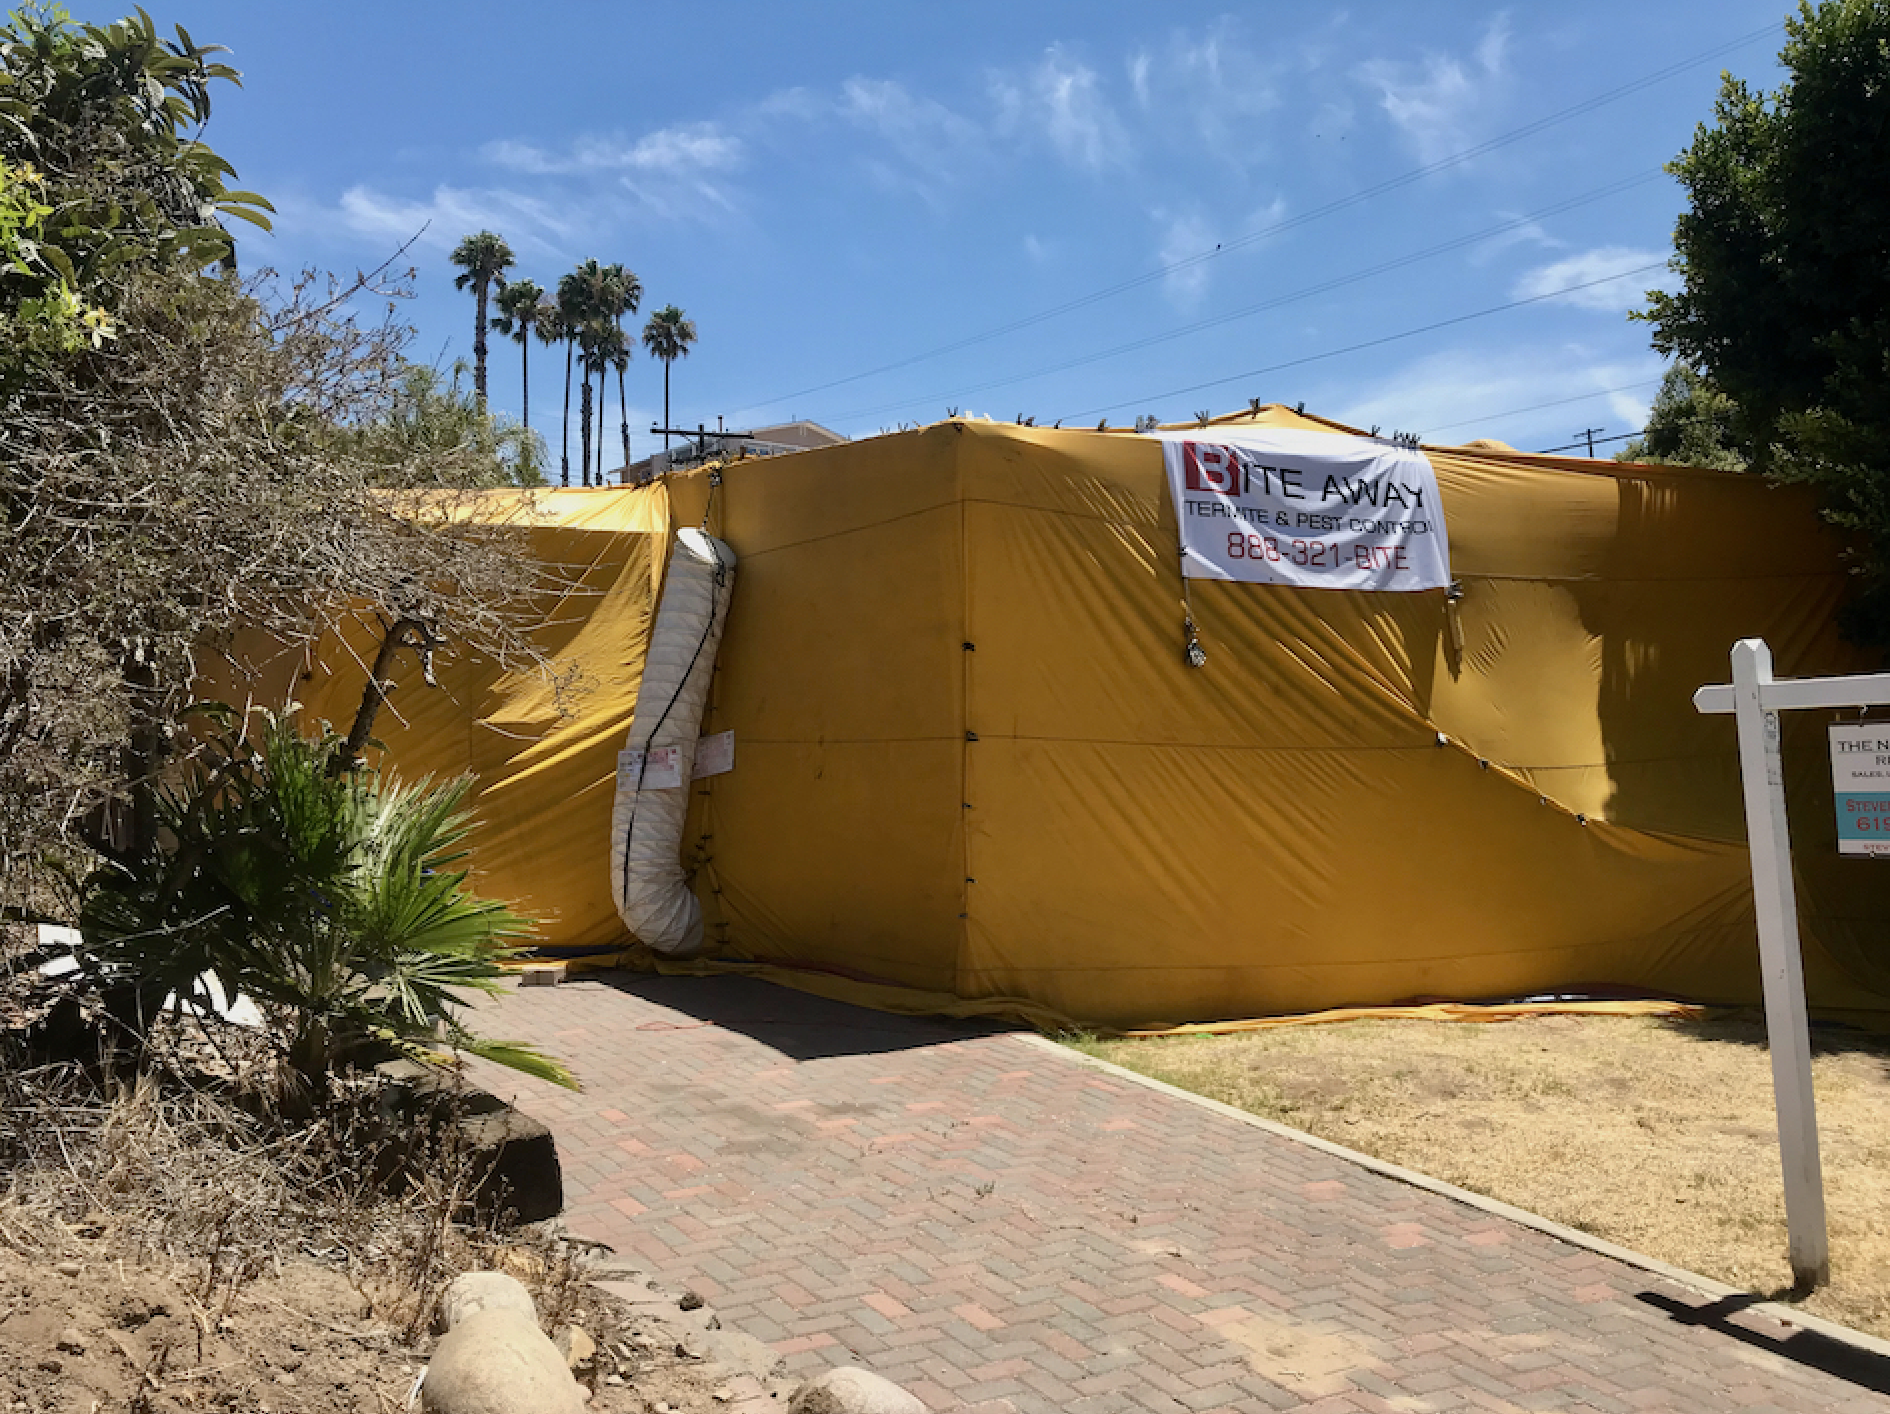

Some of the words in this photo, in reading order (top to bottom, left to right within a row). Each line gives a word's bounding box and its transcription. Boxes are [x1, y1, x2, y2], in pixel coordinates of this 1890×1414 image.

[1184, 441, 1306, 499] BITE
[1321, 474, 1423, 510] AWAY
[1276, 510, 1289, 526] &
[1296, 512, 1342, 532] PEST
[1228, 531, 1410, 571] 888-321-BITE
[1837, 740, 1872, 752] THE
